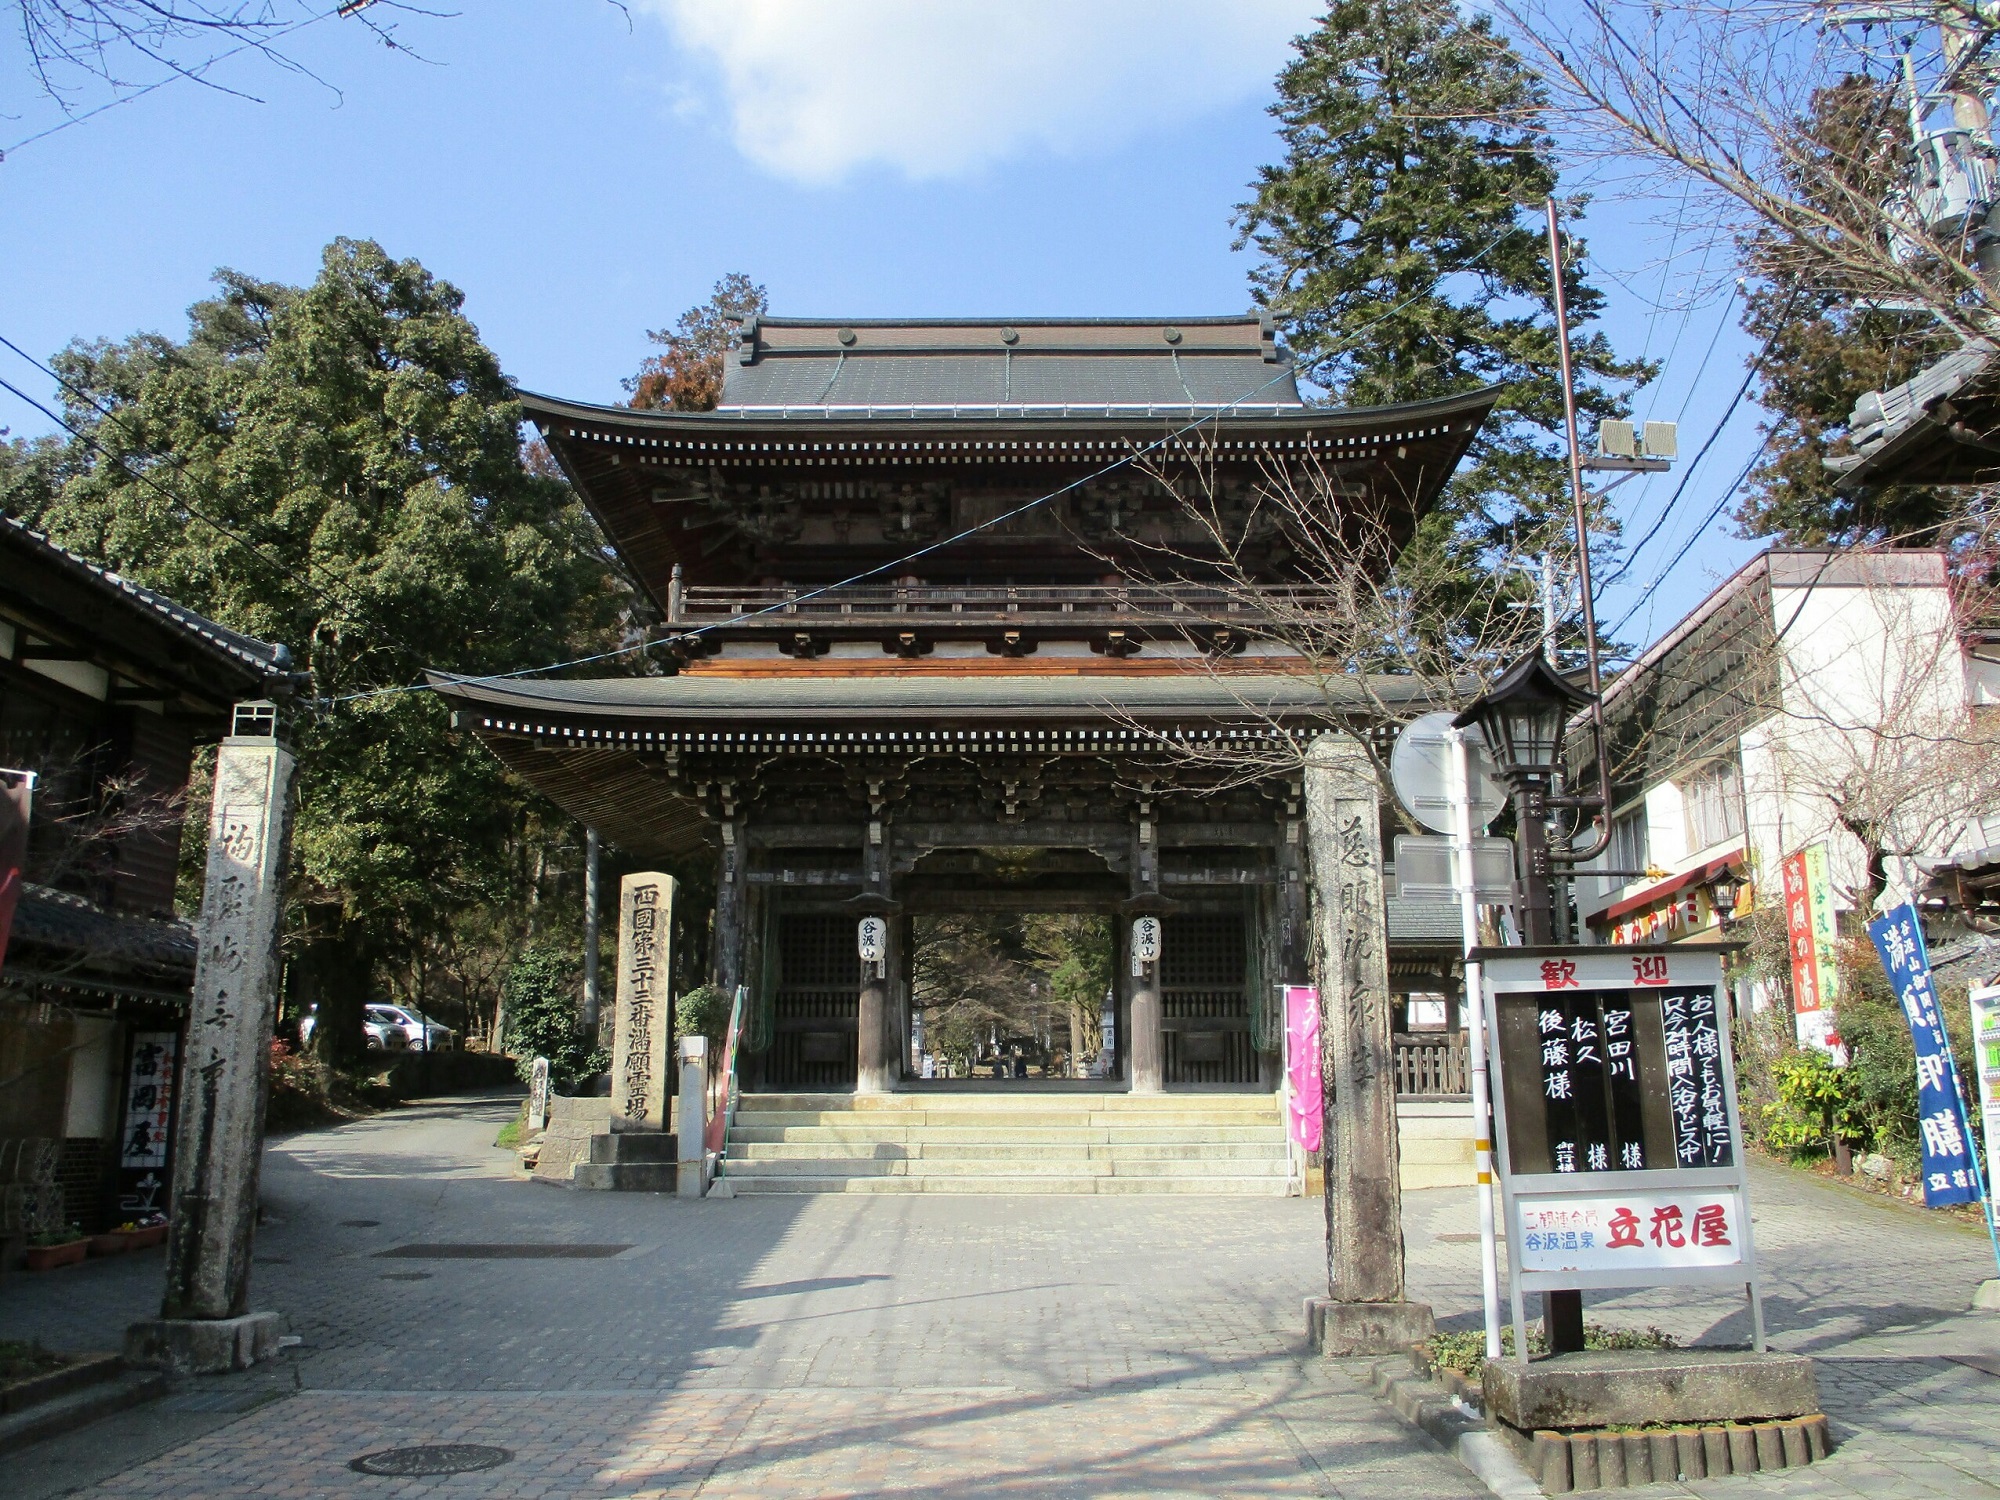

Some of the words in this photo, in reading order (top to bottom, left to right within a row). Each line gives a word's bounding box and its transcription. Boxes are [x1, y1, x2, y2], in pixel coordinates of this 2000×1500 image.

[862, 921, 877, 958] 谷汲山
[1540, 956, 1670, 990] 歓迎
[1538, 1009, 1573, 1099] 後藤様
[125, 1041, 164, 1156] 富岡屋
[1570, 1016, 1602, 1064] 松久
[1588, 1143, 1608, 1170] 様
[1604, 1010, 1635, 1080] 宮田川
[1622, 1142, 1642, 1169] 様
[1525, 1231, 1595, 1251] 谷汲温泉
[1606, 1203, 1732, 1249] 立花屋
